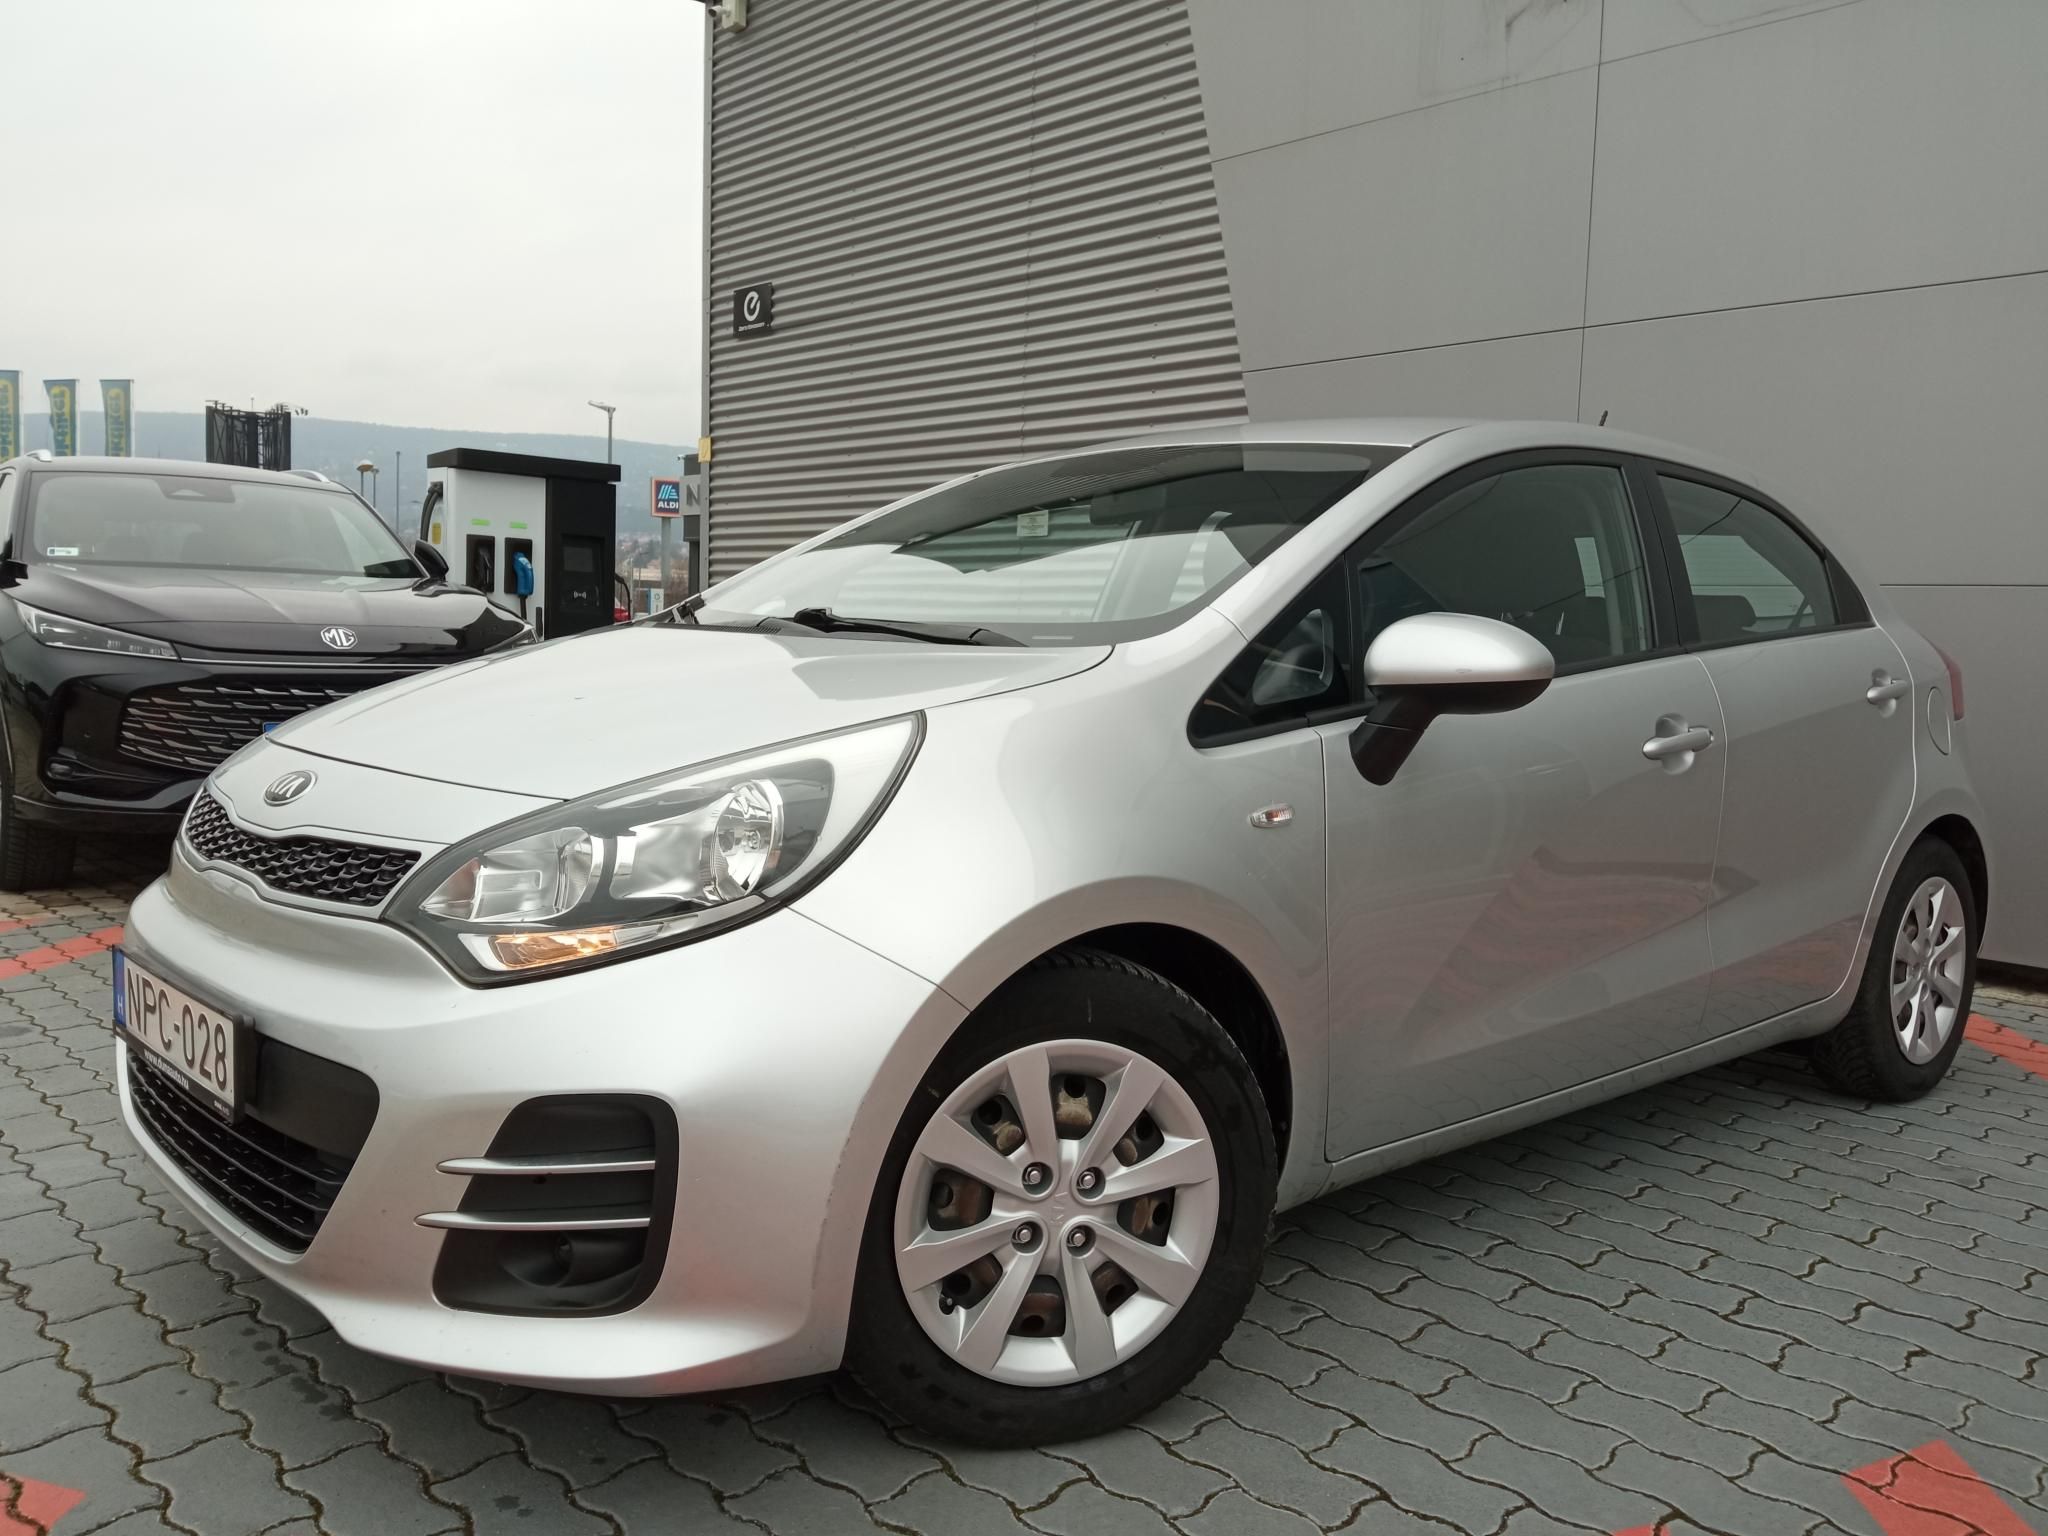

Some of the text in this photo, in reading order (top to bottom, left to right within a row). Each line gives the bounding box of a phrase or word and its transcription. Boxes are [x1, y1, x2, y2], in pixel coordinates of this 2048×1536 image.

[657, 501, 679, 509] ALDI
[323, 628, 355, 647] MG
[117, 995, 124, 1017] H
[127, 968, 227, 1091] NPC-028
